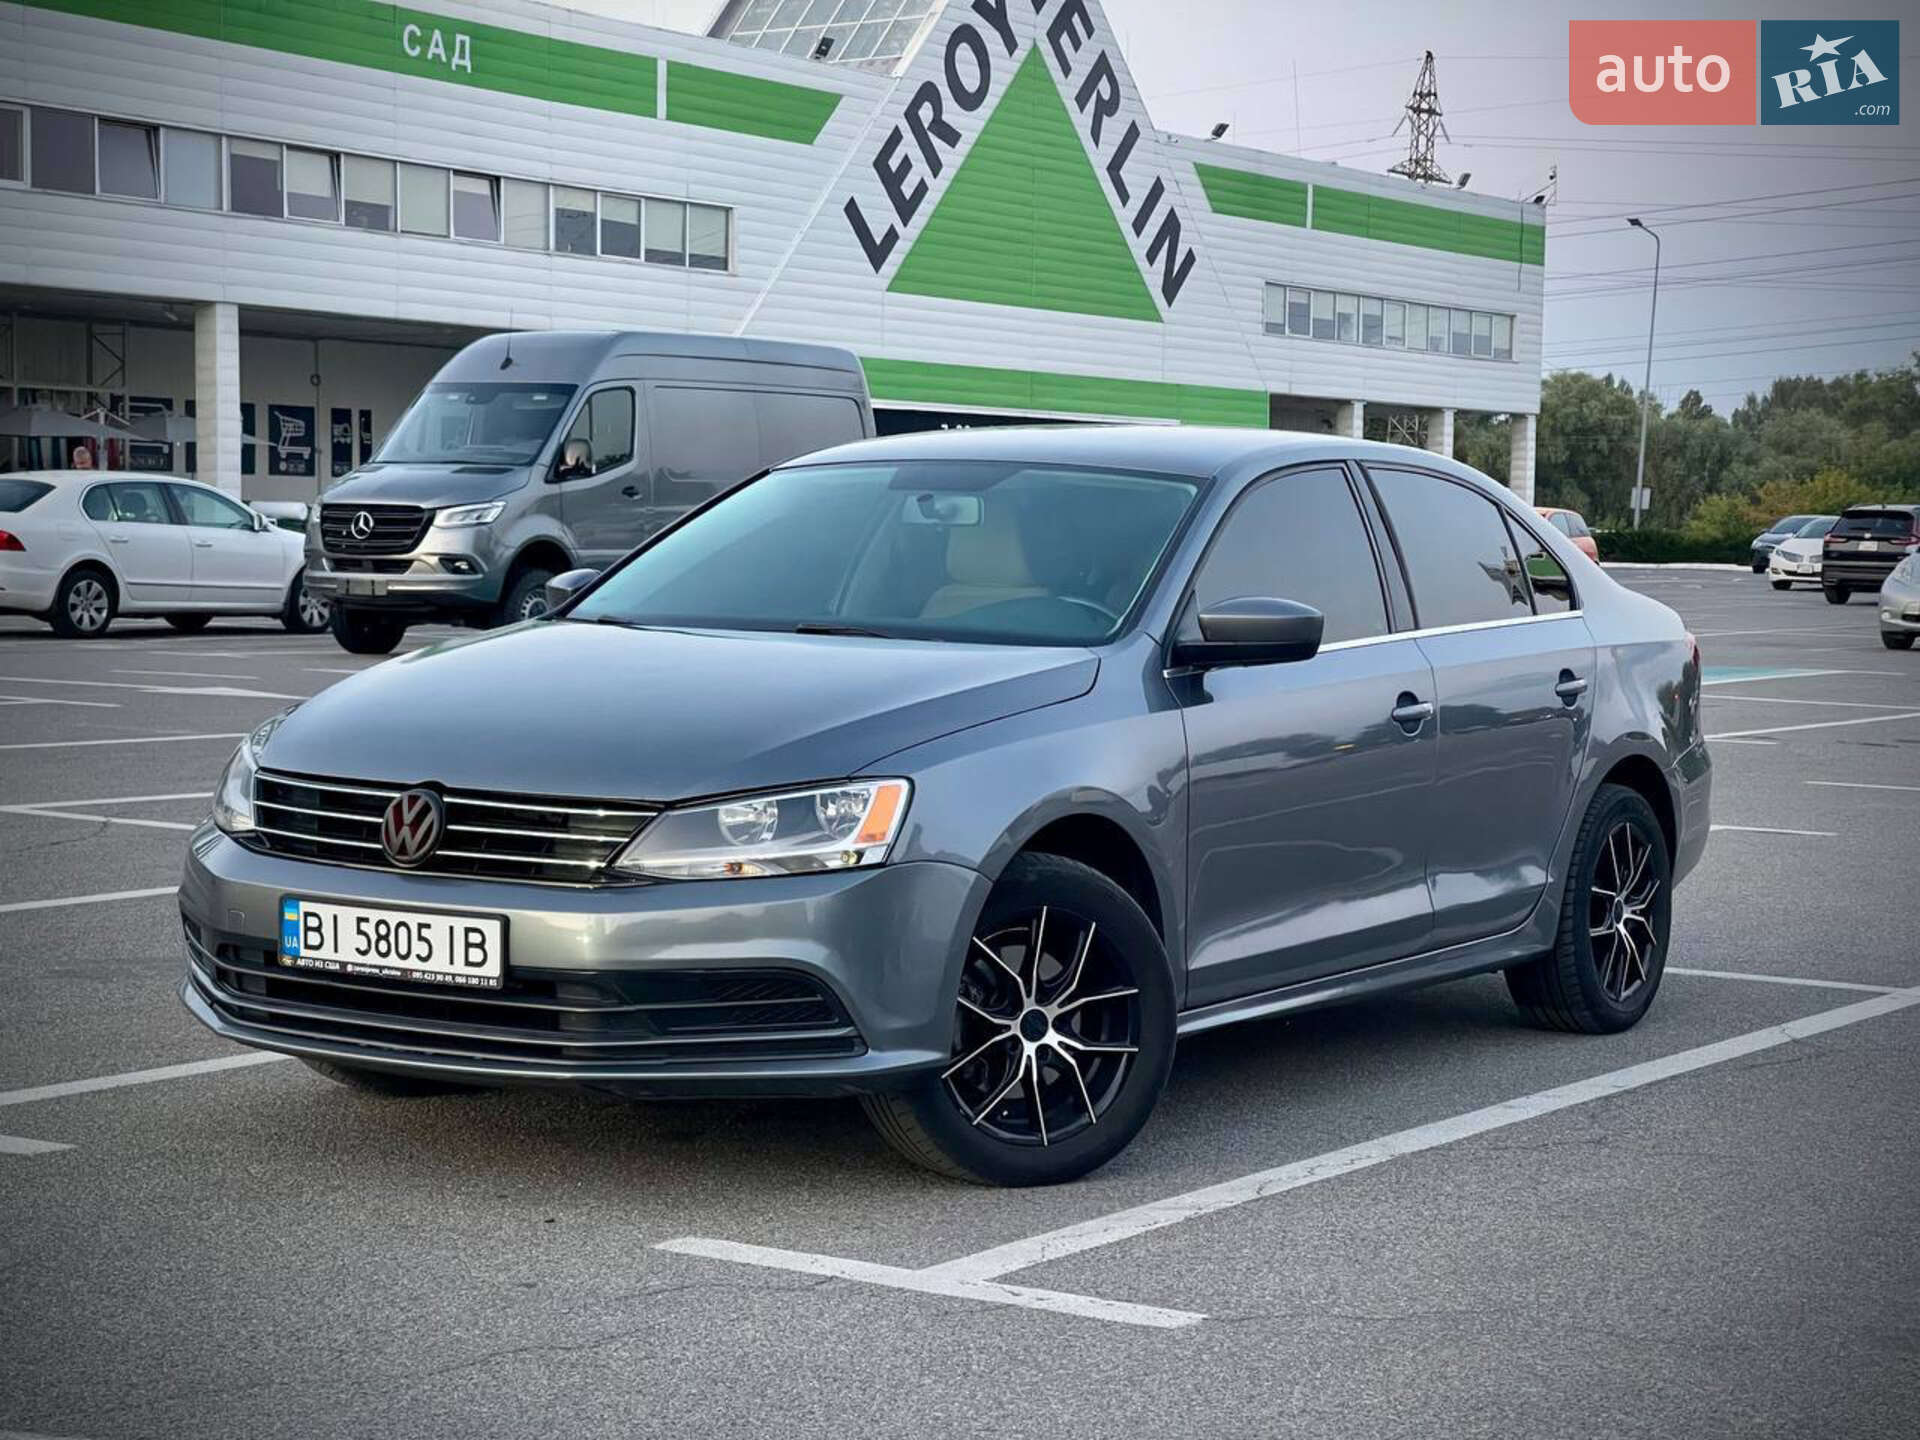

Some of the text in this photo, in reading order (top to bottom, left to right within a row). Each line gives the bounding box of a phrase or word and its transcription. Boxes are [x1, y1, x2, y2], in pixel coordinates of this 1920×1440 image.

[402, 23, 473, 73] САД
[843, 0, 1019, 274] LEROY
[1031, 0, 1196, 308] ERLIN
[284, 935, 298, 949] UA
[303, 912, 488, 968] BI 5805 IB
